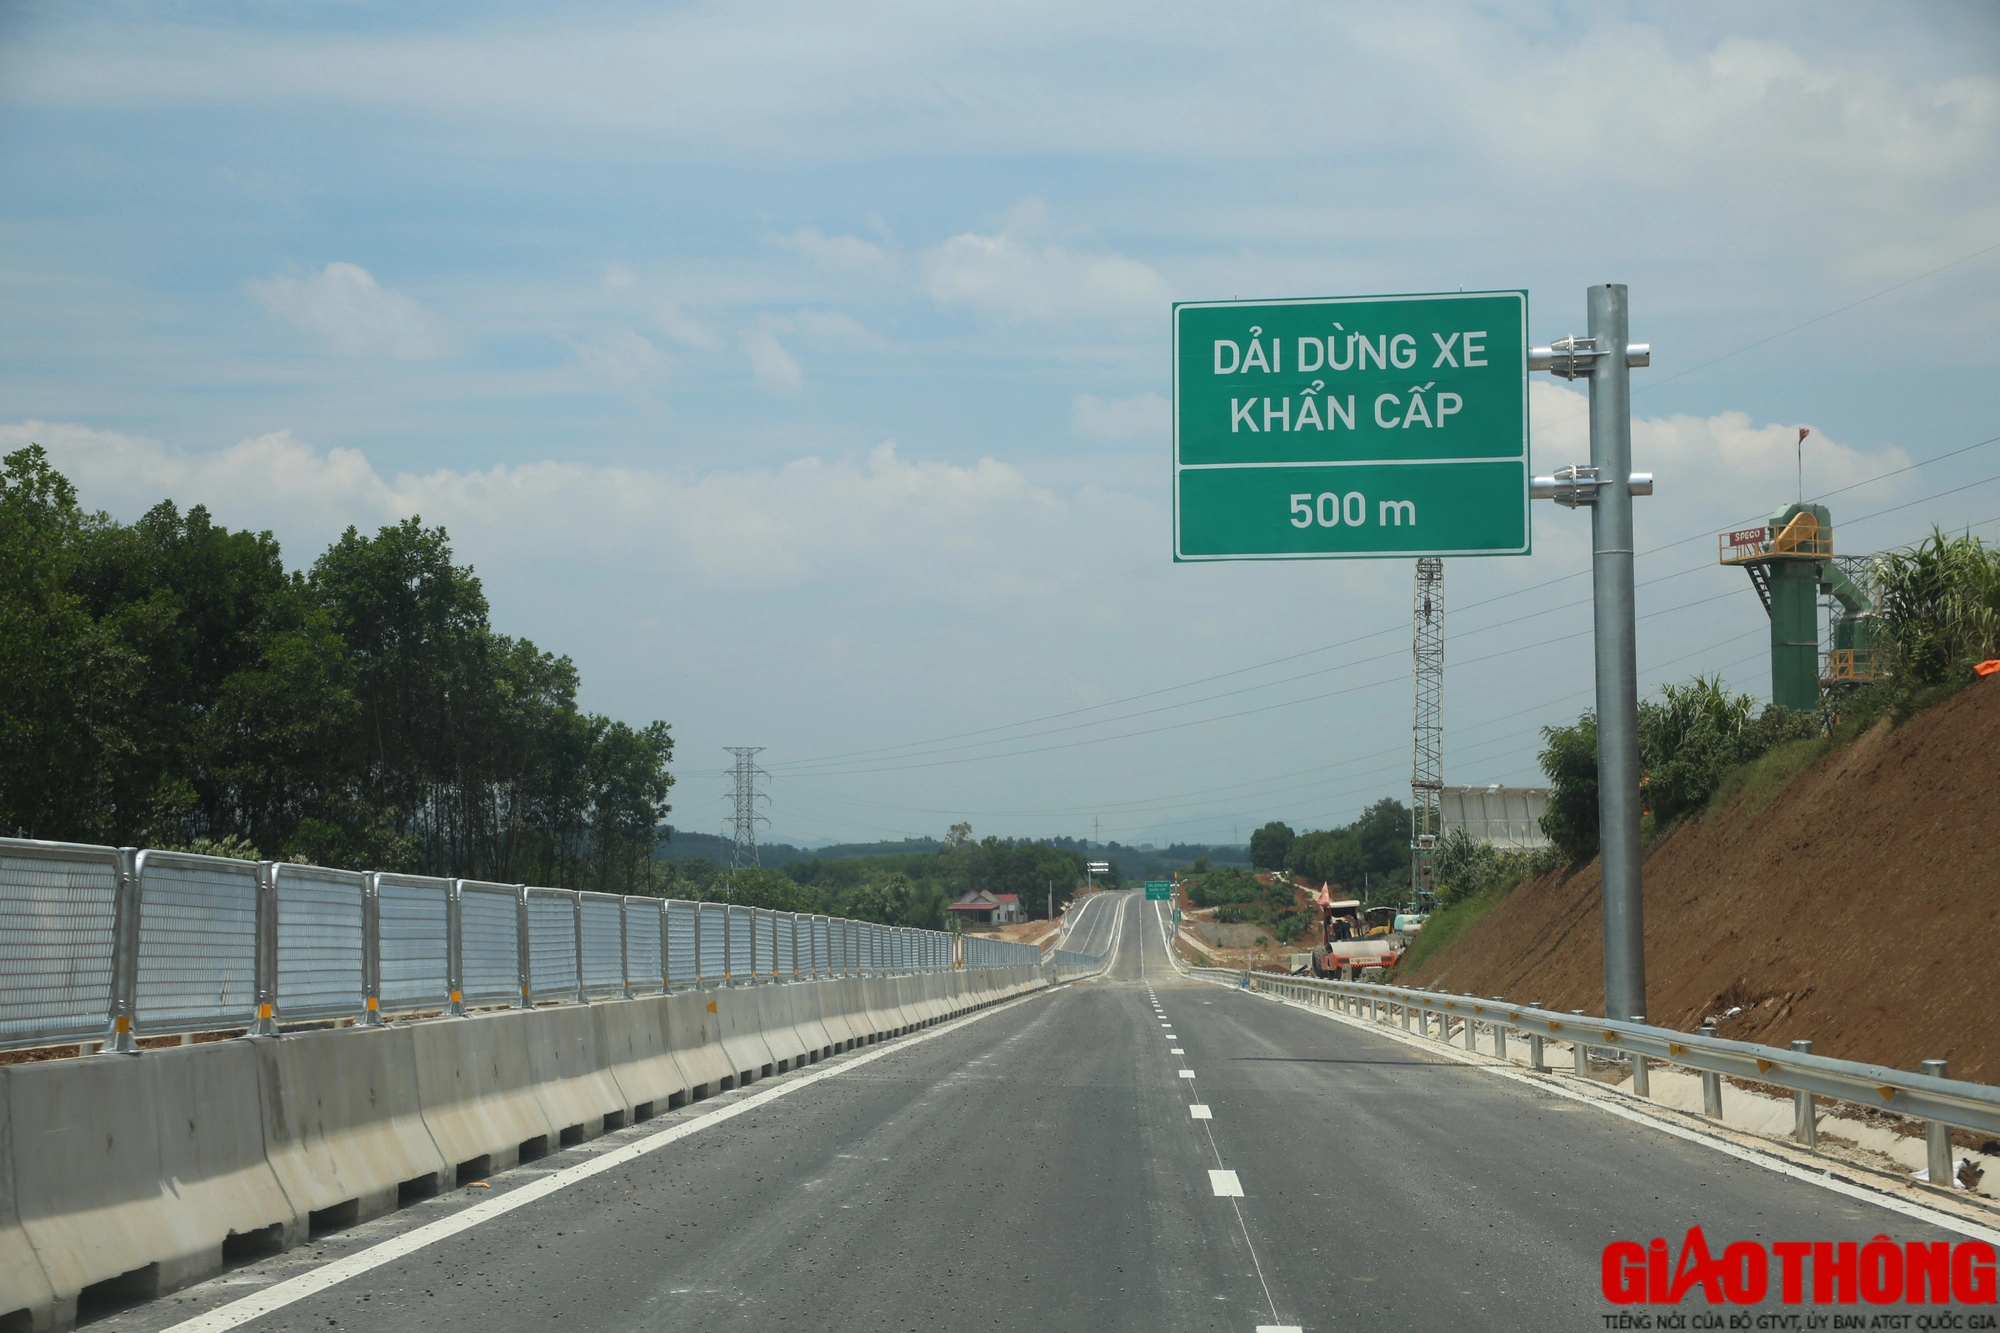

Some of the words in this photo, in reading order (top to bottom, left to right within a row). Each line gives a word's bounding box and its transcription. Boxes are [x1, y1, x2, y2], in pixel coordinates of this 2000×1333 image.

[1214, 325, 1281, 375] DẢI
[1298, 322, 1417, 372] DỪNG
[1432, 330, 1488, 368] XE
[1231, 379, 1356, 433] KHẨN
[1374, 381, 1463, 429] CẤP
[1290, 491, 1366, 529] 500
[1379, 500, 1416, 527] m
[1734, 529, 1761, 542] SPECO
